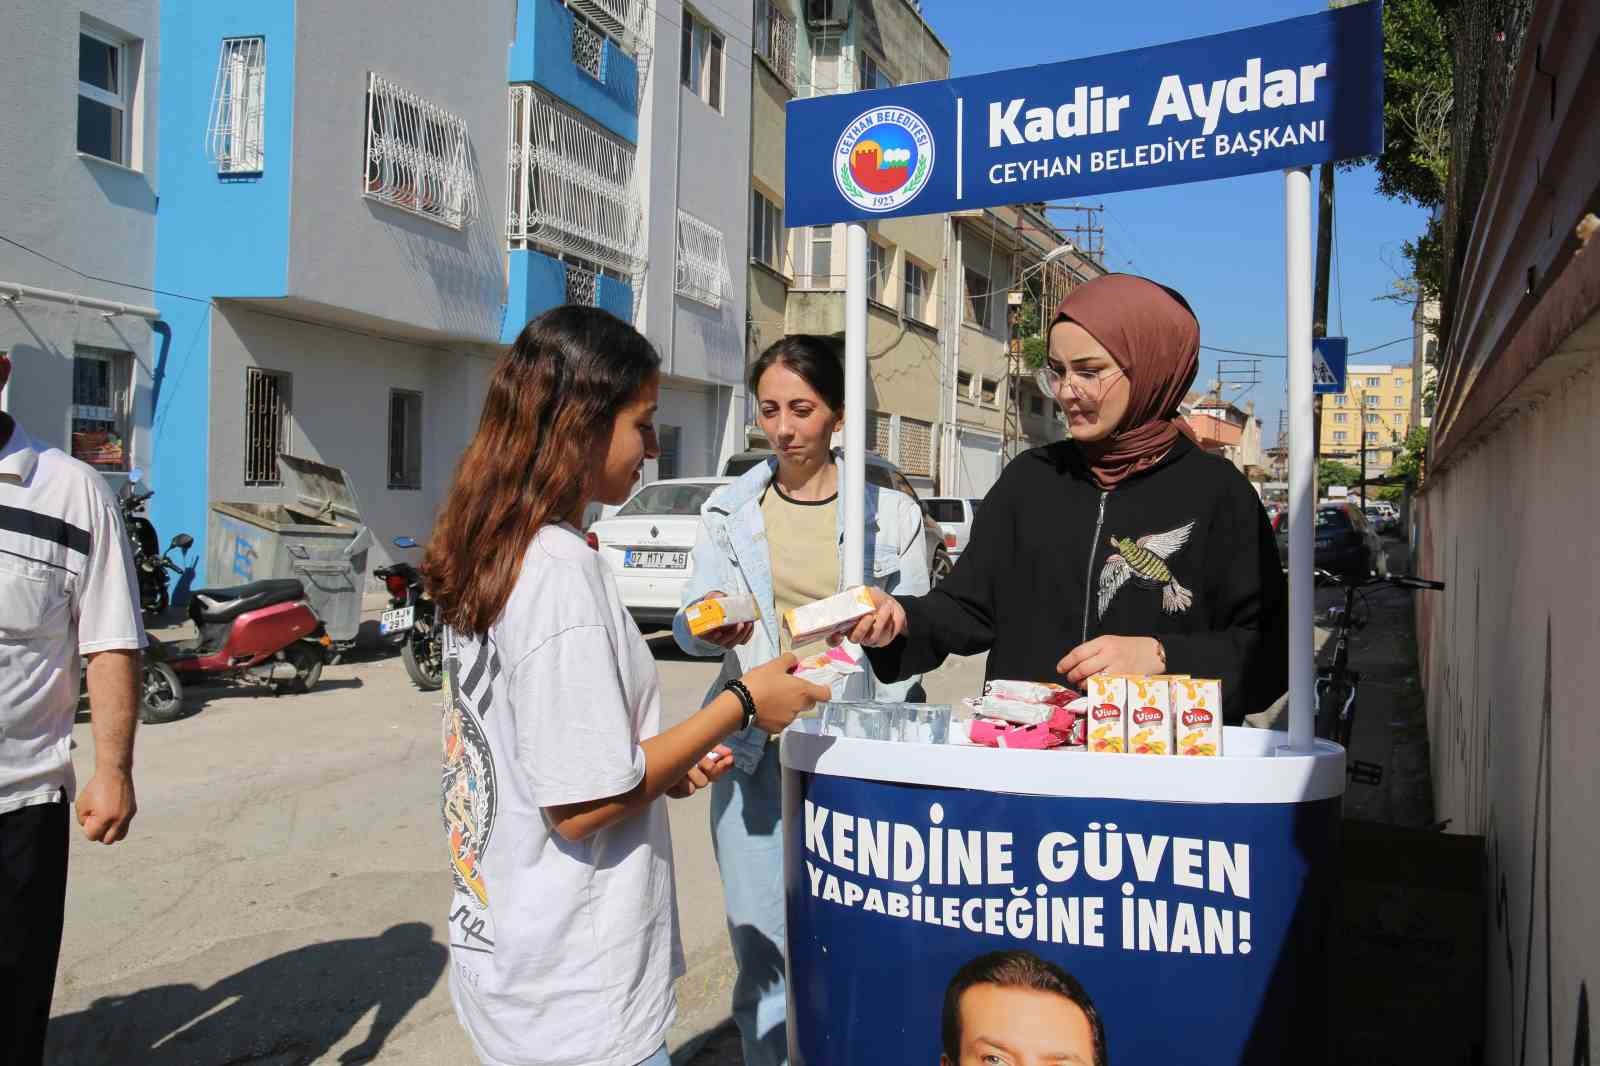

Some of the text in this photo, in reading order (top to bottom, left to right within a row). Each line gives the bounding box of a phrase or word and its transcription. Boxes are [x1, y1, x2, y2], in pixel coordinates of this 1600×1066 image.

[988, 57, 1327, 147] Kadir Aydar
[839, 115, 873, 155] CEYHAN
[988, 119, 1326, 185] CEYHAN BELEDİYE BAŞKANI
[871, 195, 895, 206] 1923
[1095, 708, 1118, 717] Viva
[1136, 711, 1161, 721] Viva
[1185, 713, 1210, 723] Viva
[804, 799, 1251, 900] KENDİNE GÜVEN
[805, 860, 1252, 955] YAPABİLECEĞİNE İNAN!
